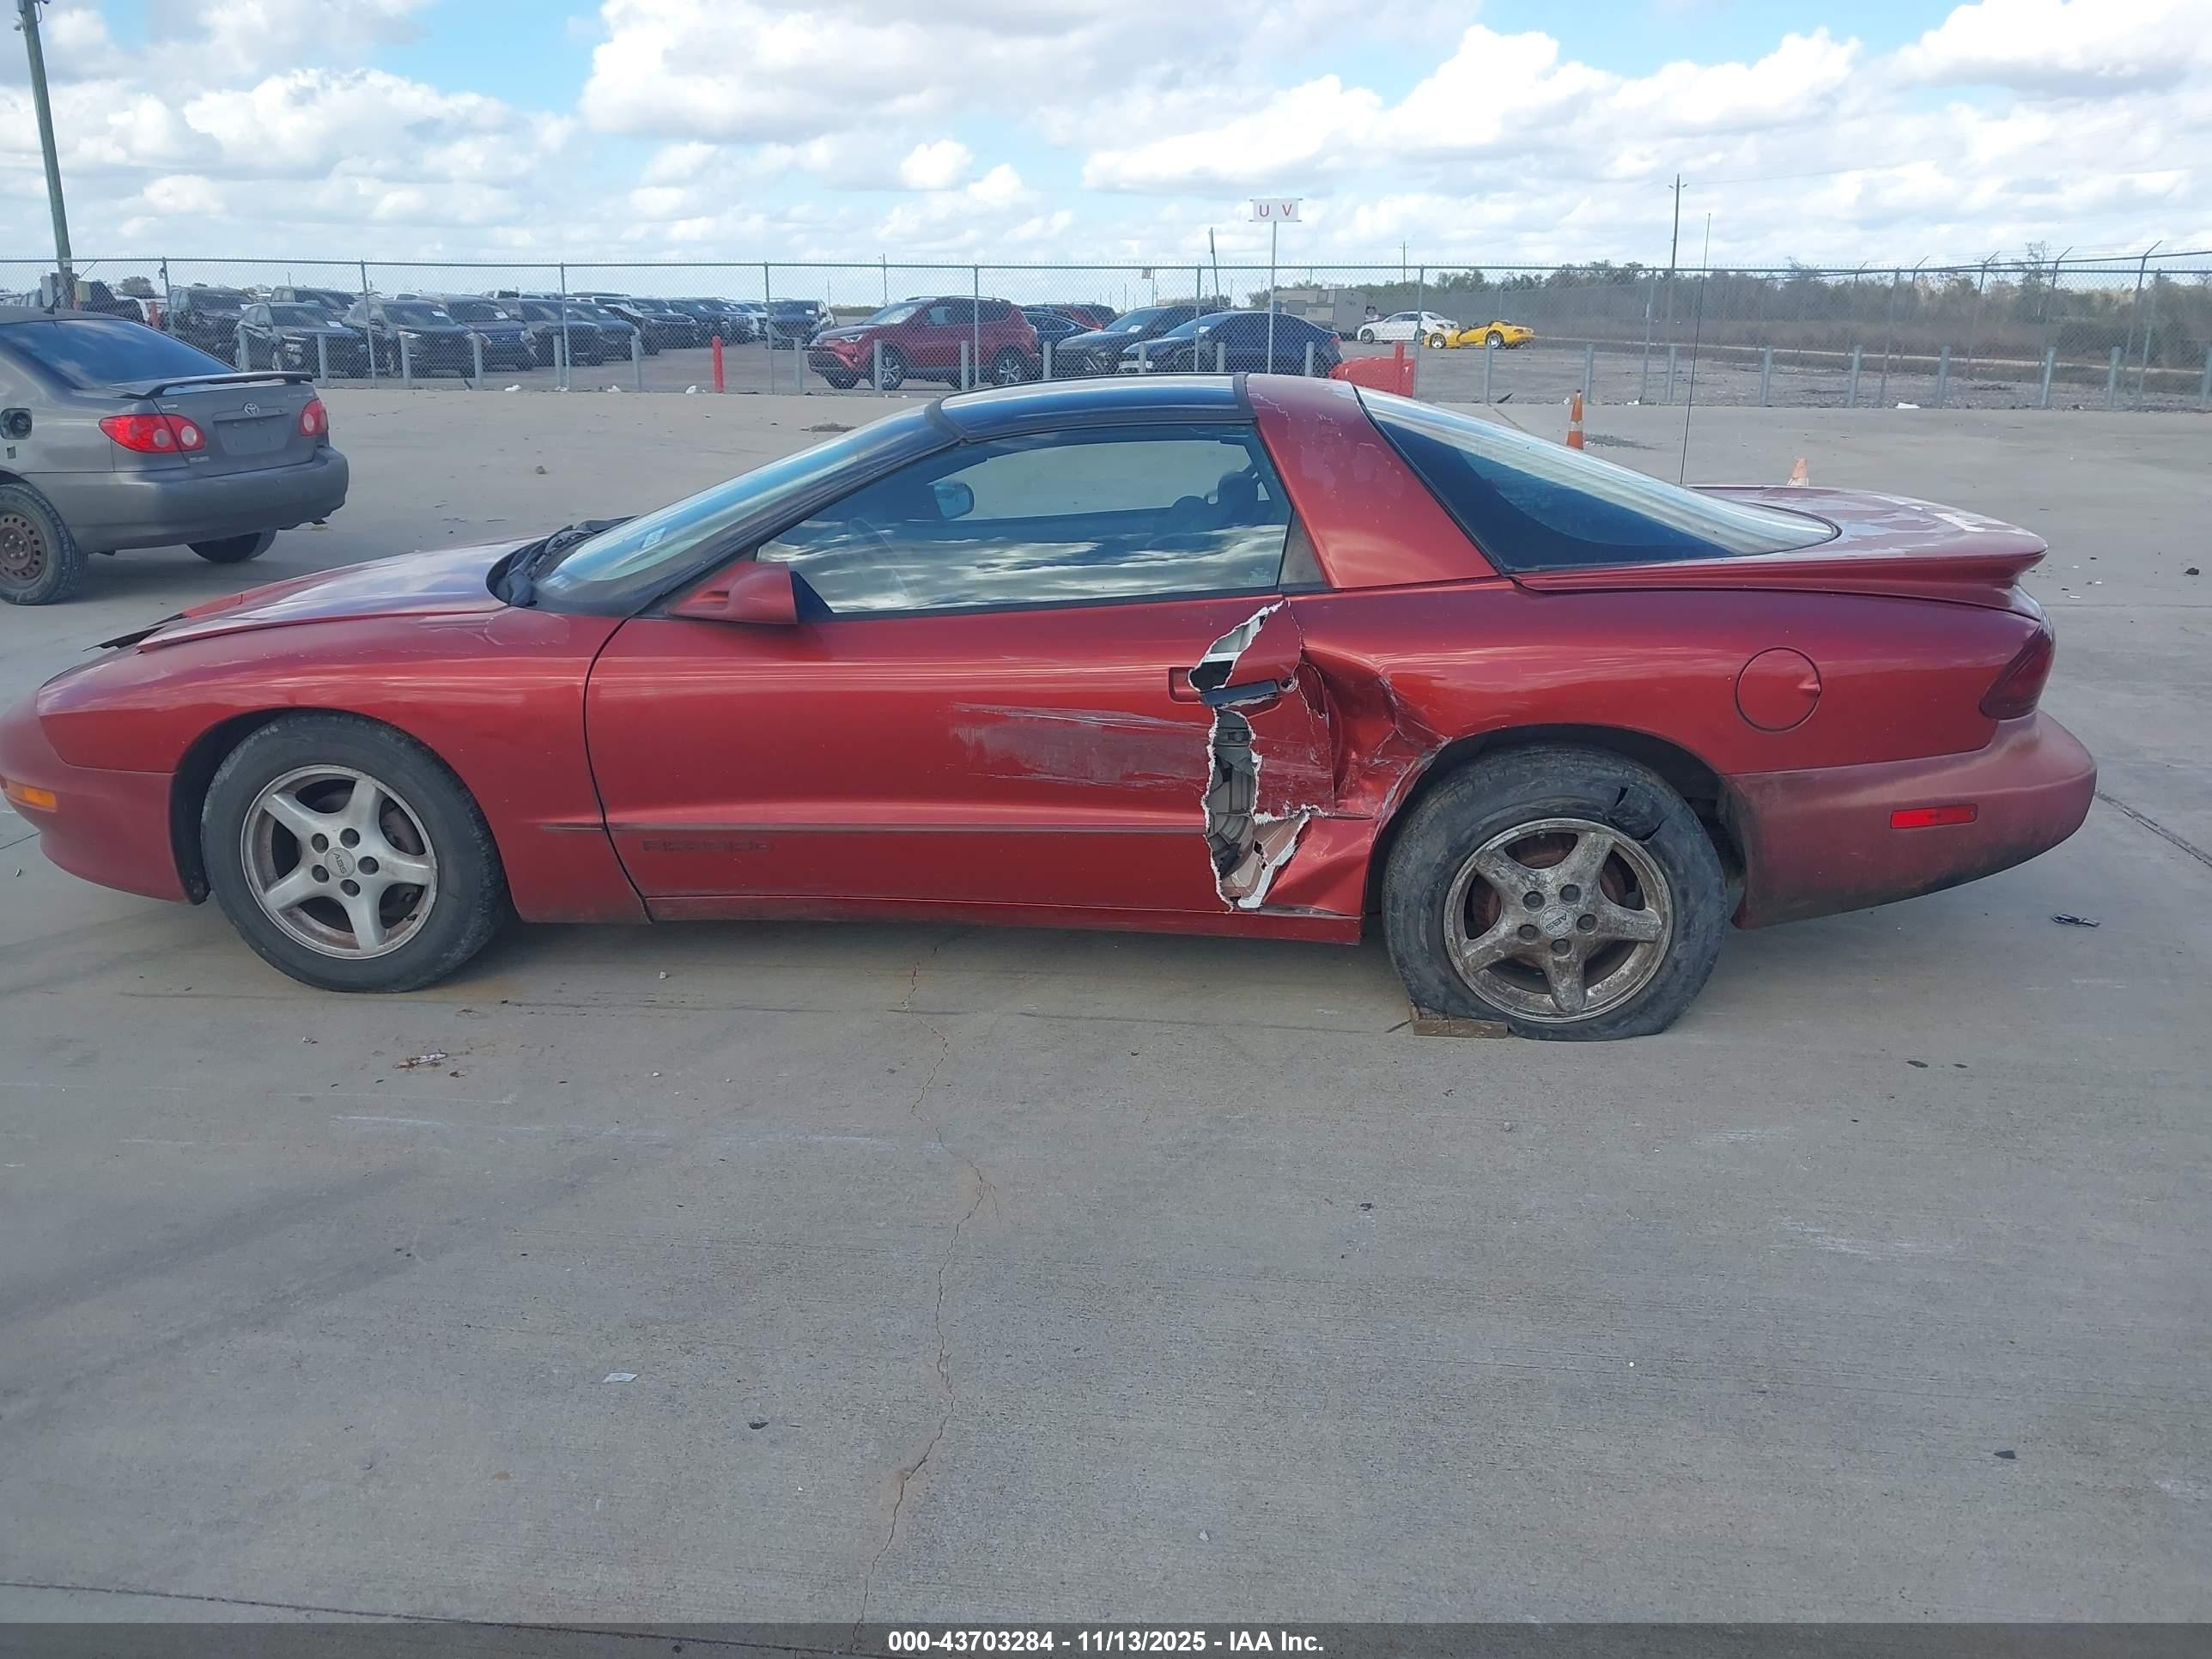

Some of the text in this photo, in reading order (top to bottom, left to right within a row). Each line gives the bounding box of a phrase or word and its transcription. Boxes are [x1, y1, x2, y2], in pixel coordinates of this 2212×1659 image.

[1259, 204, 1292, 217] U V
[331, 851, 347, 874] ABS
[1546, 913, 1567, 932] ABS
